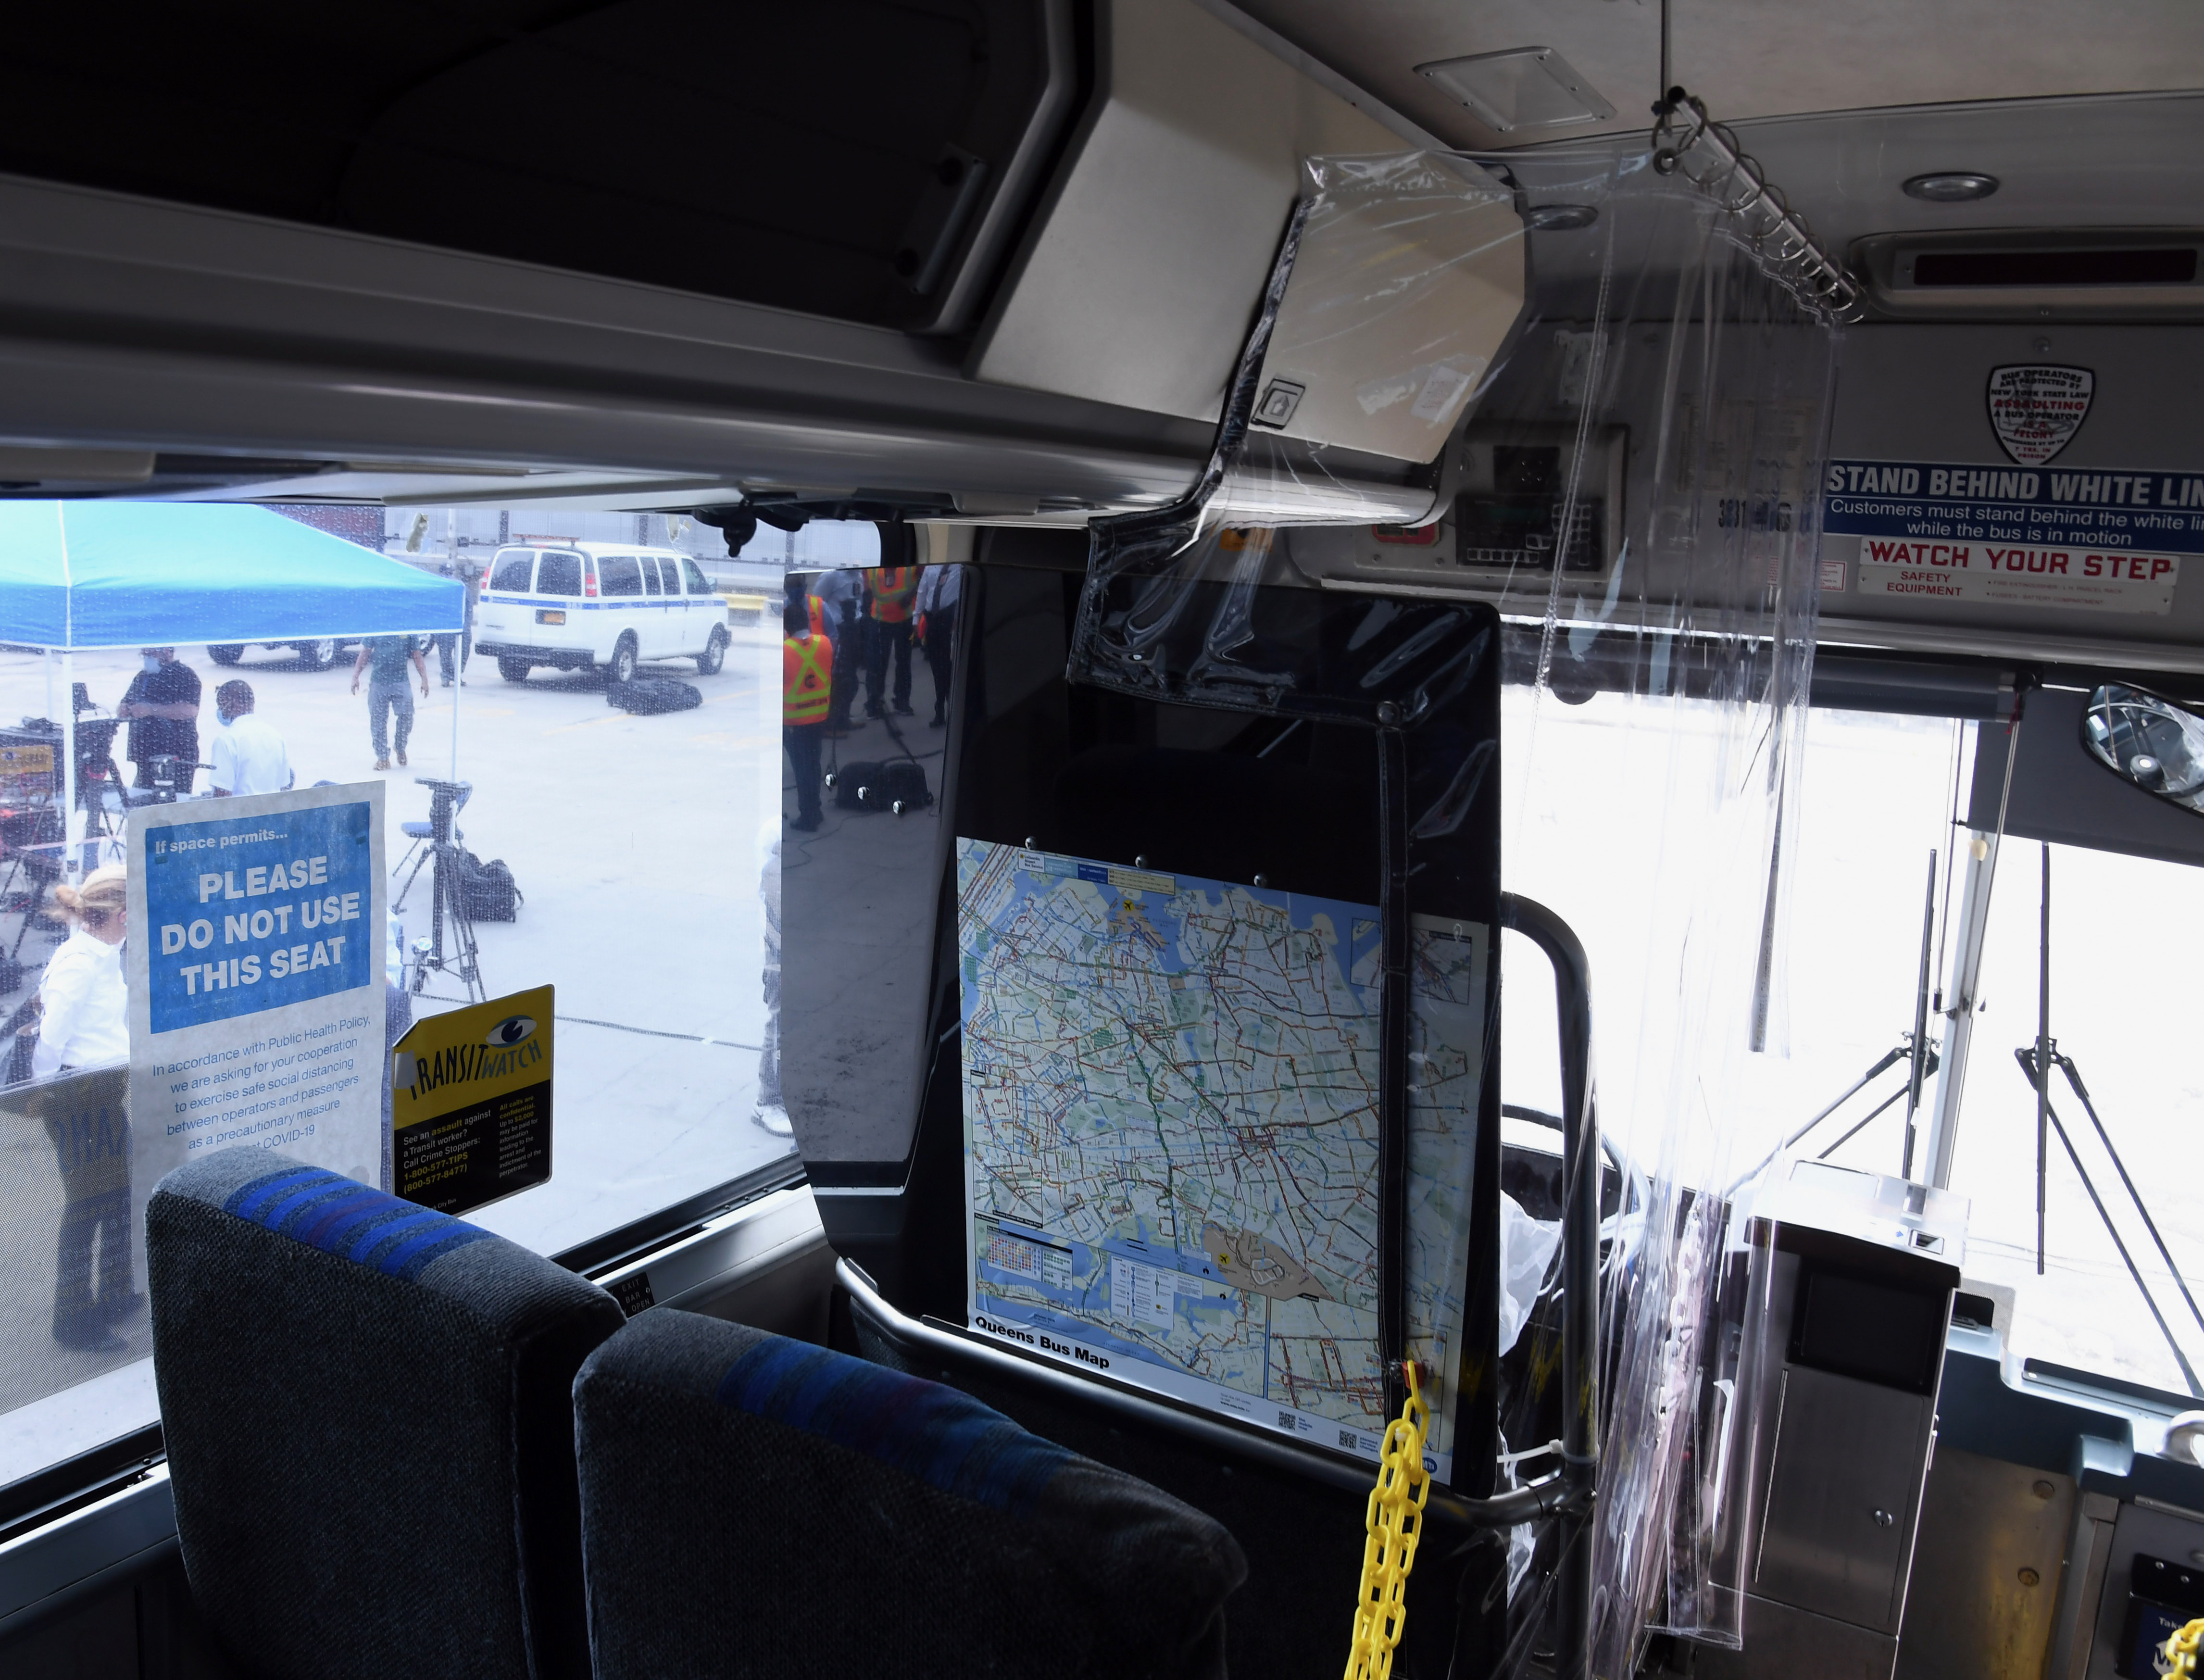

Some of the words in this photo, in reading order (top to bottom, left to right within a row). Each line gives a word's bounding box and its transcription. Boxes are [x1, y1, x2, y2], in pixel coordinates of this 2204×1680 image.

[2000, 379, 2016, 387] ARE
[2019, 377, 2066, 387] PROTECTED
[2002, 371, 2020, 380] BUS
[2024, 370, 2082, 382] OPERATORS
[1994, 399, 2085, 411] ASSAULTING
[2027, 412, 2079, 420] OPERATOR
[2014, 429, 2054, 439] FELONY
[1828, 465, 1919, 494] STAND
[1929, 468, 2040, 499] BEHIND
[2051, 474, 2152, 505] WHITE
[1830, 499, 1922, 517] Customers
[1928, 505, 1970, 519] must
[1975, 507, 2025, 522] stand
[2030, 508, 2093, 526] behind
[2098, 512, 2128, 527] the
[2134, 514, 2184, 530] white
[1907, 521, 1951, 536] while
[1956, 523, 1983, 538] the
[1990, 525, 2021, 539] bus
[2027, 526, 2041, 541] is
[2047, 527, 2063, 542] in
[2069, 530, 2132, 546] motion
[1869, 541, 1969, 567] WATCH
[1986, 548, 2068, 574] YOUR
[2084, 554, 2171, 580] STEP
[1887, 582, 1963, 597] EQUIPMENT
[1901, 571, 1951, 583] SAFETY
[155, 840, 165, 854] If
[170, 838, 215, 853] space
[220, 828, 288, 849] permits...
[199, 855, 327, 903] PLEASE
[161, 919, 214, 955] DO
[225, 905, 293, 944] NOT
[302, 892, 360, 929] USE
[180, 955, 262, 995] THIS
[270, 936, 346, 978] SEAT
[153, 1064, 164, 1077] In
[168, 1049, 239, 1074] accordance
[242, 1041, 266, 1057] with
[269, 1034, 302, 1050] Public
[304, 1023, 337, 1040] Health
[339, 1015, 371, 1031] Policy,
[170, 1082, 188, 1094] we
[191, 1077, 211, 1090] are
[213, 1066, 251, 1084] asking
[253, 1061, 269, 1075] for
[271, 1055, 295, 1074] your
[297, 1038, 358, 1063] cooperation
[175, 1100, 187, 1114] to
[189, 1089, 239, 1110] exercise
[242, 1081, 266, 1097] safe
[268, 1072, 300, 1091] social
[301, 1058, 354, 1081] distancing
[167, 1114, 219, 1136] between
[221, 1100, 276, 1124] operators
[279, 1091, 299, 1107] and
[301, 1075, 359, 1103] passengers
[500, 1103, 508, 1111] All
[509, 1099, 523, 1108] calls
[500, 1103, 535, 1119] confidential.
[188, 1139, 203, 1150] as
[206, 1135, 213, 1145] a
[216, 1113, 295, 1147] precautionary
[297, 1099, 340, 1120] measure
[404, 1135, 418, 1145] See
[420, 1131, 429, 1140] an
[431, 1119, 463, 1136] assault
[464, 1109, 491, 1125] against
[500, 1120, 507, 1128] Up
[514, 1111, 534, 1122] $2,000
[500, 1128, 510, 1136] may
[519, 1121, 530, 1131] paid
[263, 1124, 315, 1150] COVID-19
[410, 1141, 436, 1156] Transit
[438, 1129, 467, 1146] worker?
[499, 1129, 528, 1144] information
[499, 1142, 518, 1153] leading
[403, 1157, 419, 1169] Call
[421, 1151, 443, 1163] Crime
[445, 1137, 480, 1154] Stoppers:
[499, 1152, 514, 1161] arrest
[515, 1146, 525, 1155] and
[499, 1155, 526, 1169] indictment
[533, 1148, 541, 1156] the
[404, 1152, 468, 1181] 1-800-577-TIPS
[404, 1163, 467, 1194] (800-577-8477)
[499, 1163, 529, 1178] perpetrator.
[622, 1278, 639, 1292] EXIT
[625, 1291, 640, 1304] BAR
[631, 1298, 650, 1312] OPEN
[976, 1316, 1035, 1345] Queens
[1040, 1335, 1070, 1356] Bus
[1075, 1347, 1110, 1369] Map
